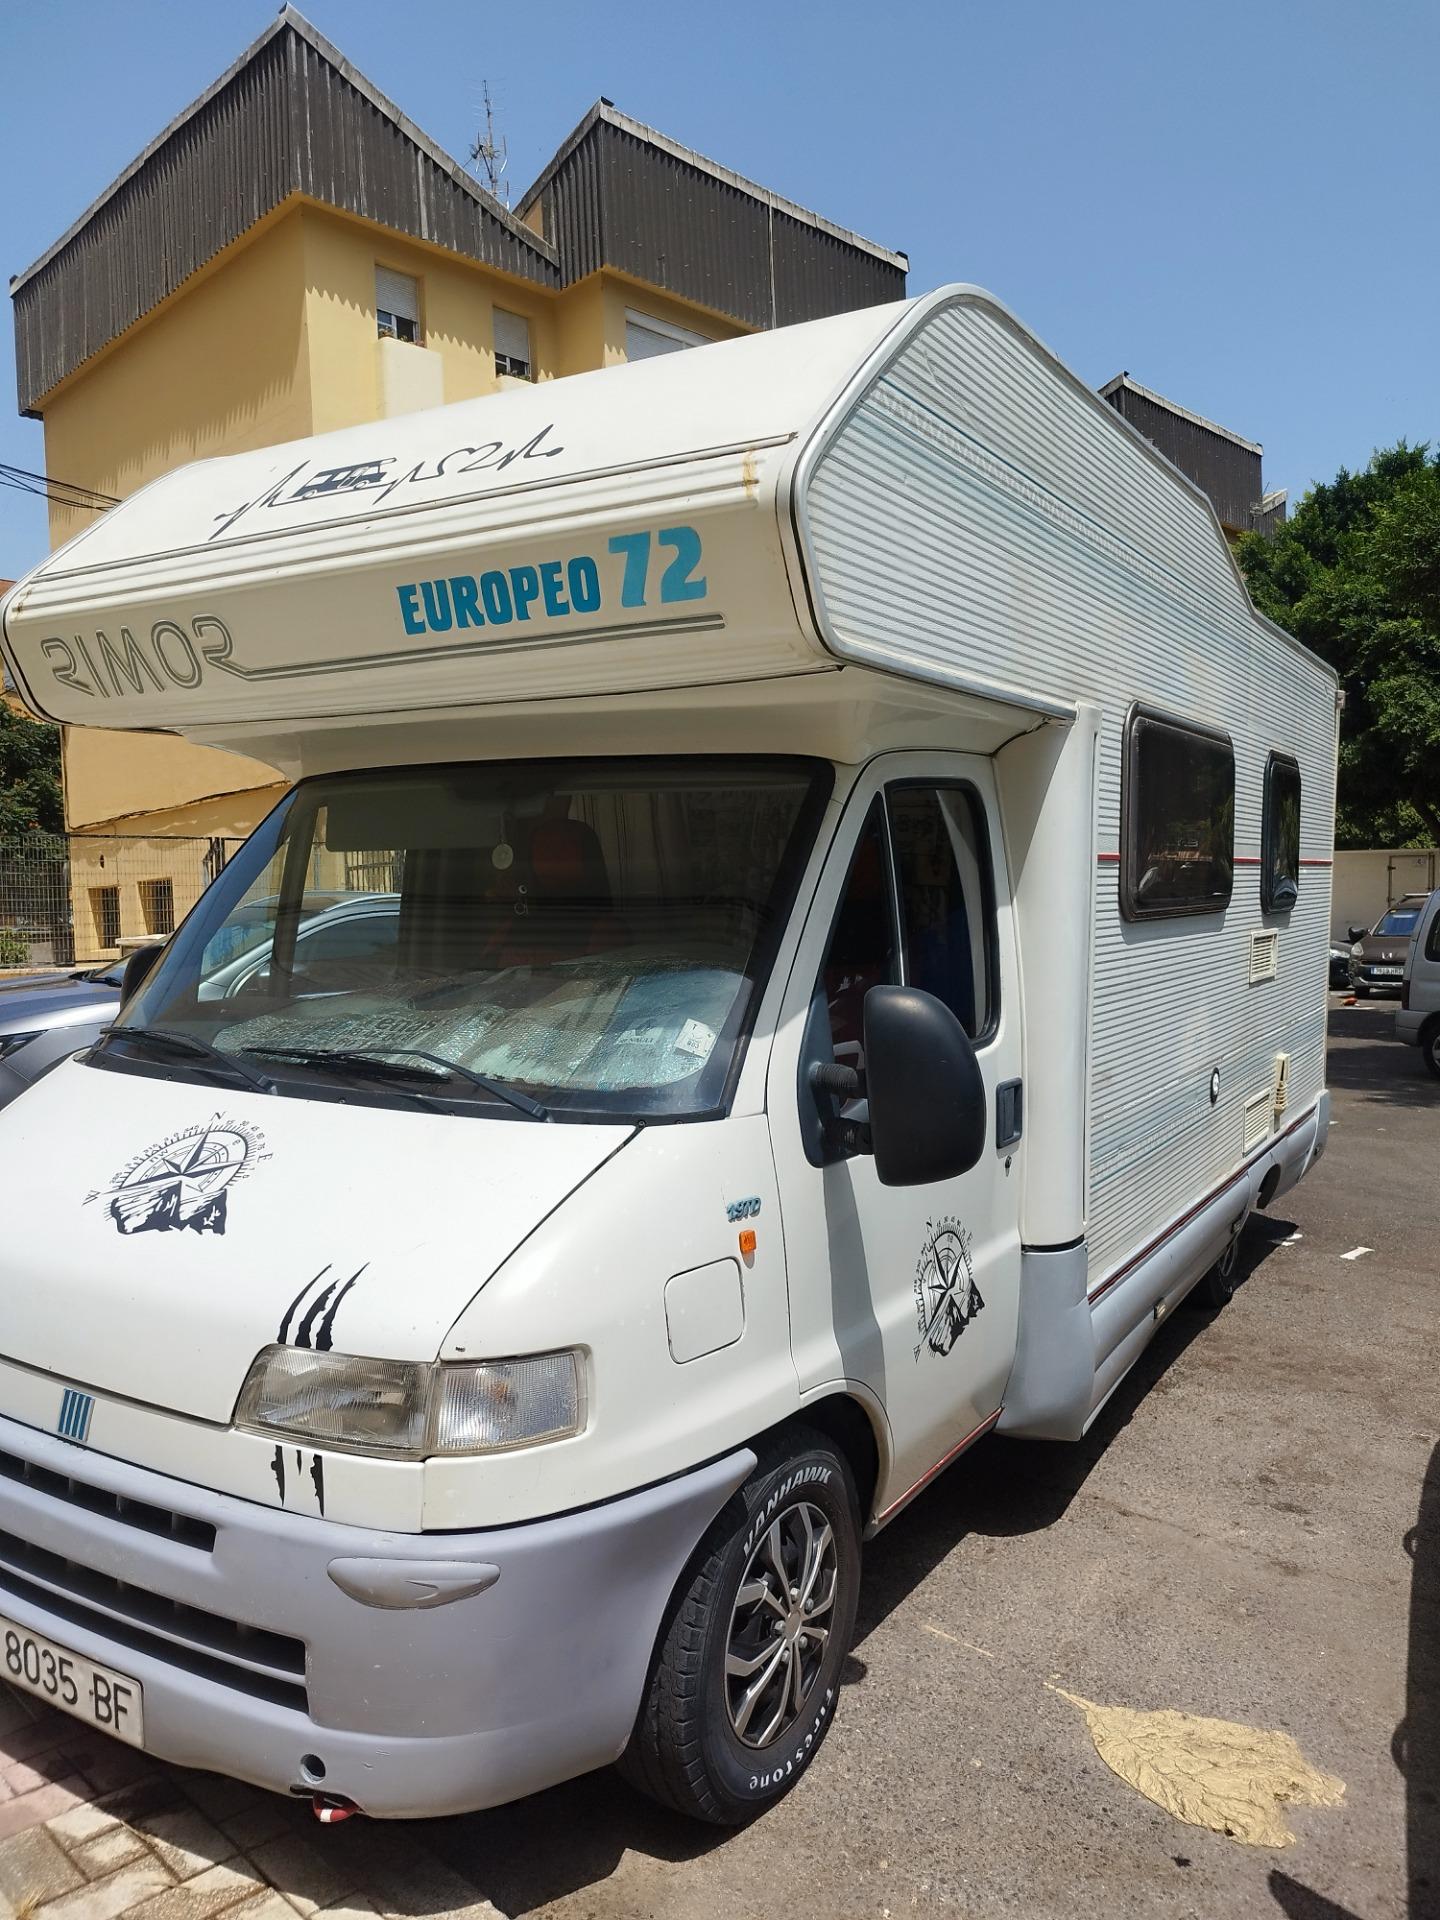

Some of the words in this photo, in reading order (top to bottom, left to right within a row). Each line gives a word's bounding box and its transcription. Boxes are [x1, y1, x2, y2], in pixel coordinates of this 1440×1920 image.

[396, 556, 601, 635] EUROPEO
[608, 526, 707, 608] 72
[40, 613, 234, 699] RIMOR
[209, 1111, 227, 1122] N
[743, 1466, 832, 1557] VANHAWK
[5, 1630, 78, 1705] 8035
[92, 1672, 132, 1730] BF
[749, 1687, 834, 1790] Firestone
